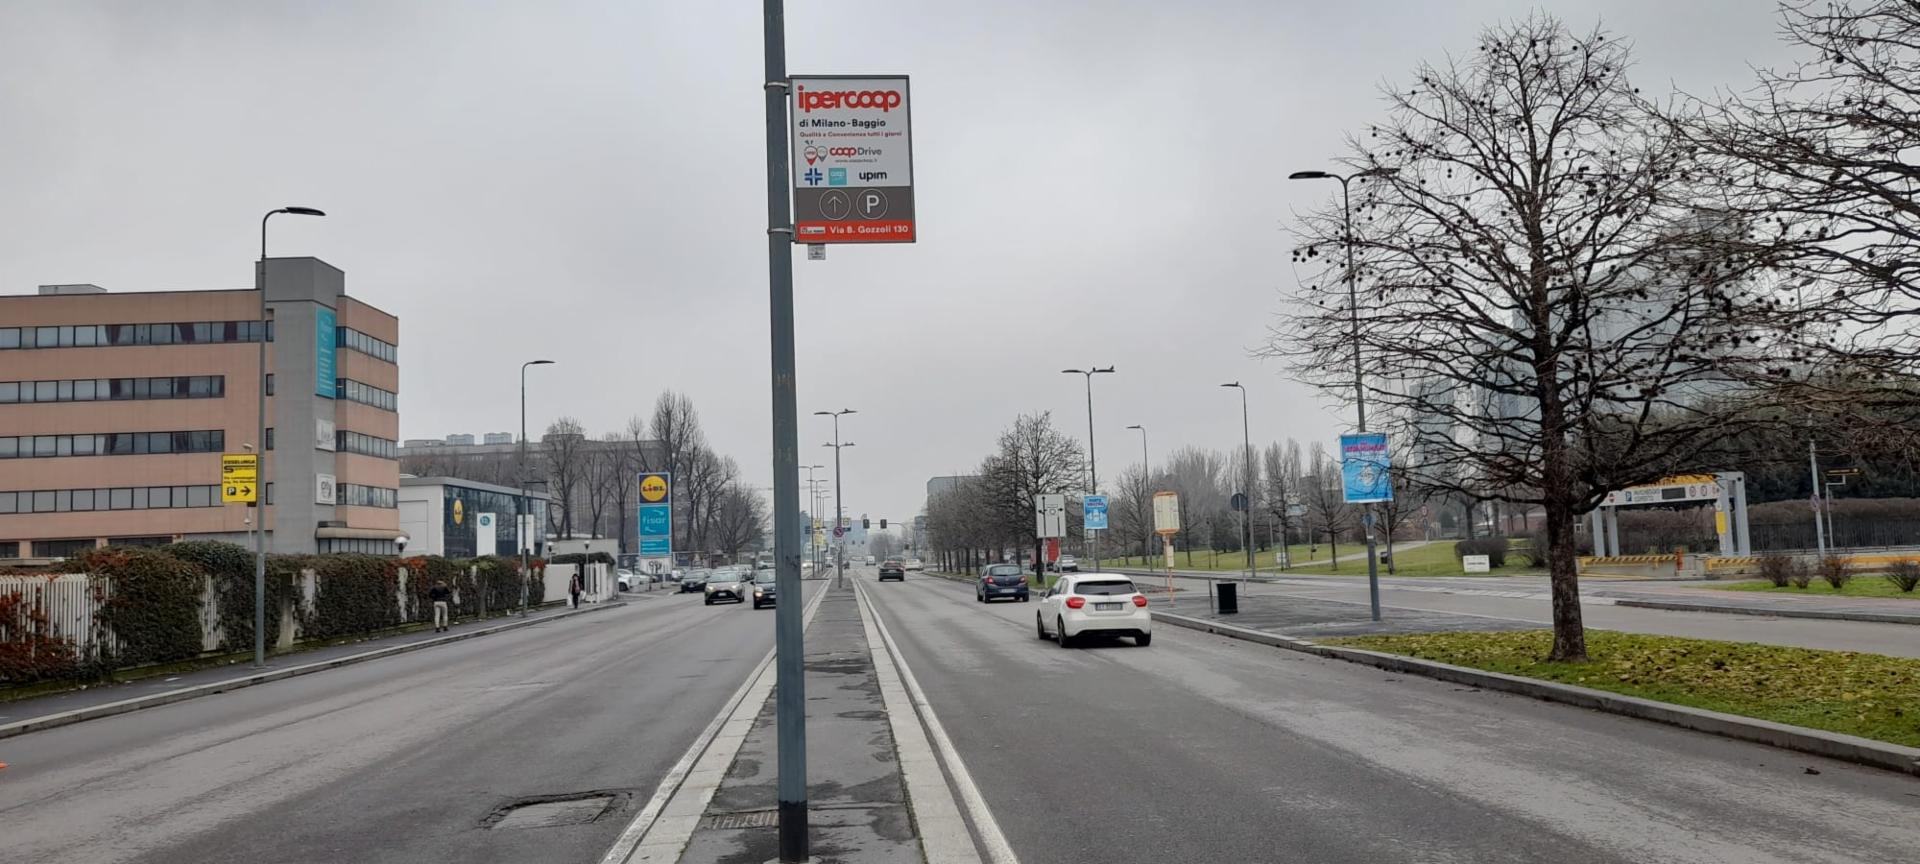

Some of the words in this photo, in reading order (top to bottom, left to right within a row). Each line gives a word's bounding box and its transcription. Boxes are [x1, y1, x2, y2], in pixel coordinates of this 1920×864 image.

[797, 85, 901, 113] ipercoop
[799, 119, 809, 128] di
[811, 118, 886, 129] Milano-Baggio
[829, 147, 857, 158] coop
[857, 147, 882, 156] Drive
[859, 171, 887, 182] upim
[866, 195, 880, 214] P
[830, 226, 845, 234] Via
[857, 225, 891, 234] Gozzoli
[893, 225, 909, 233] 130
